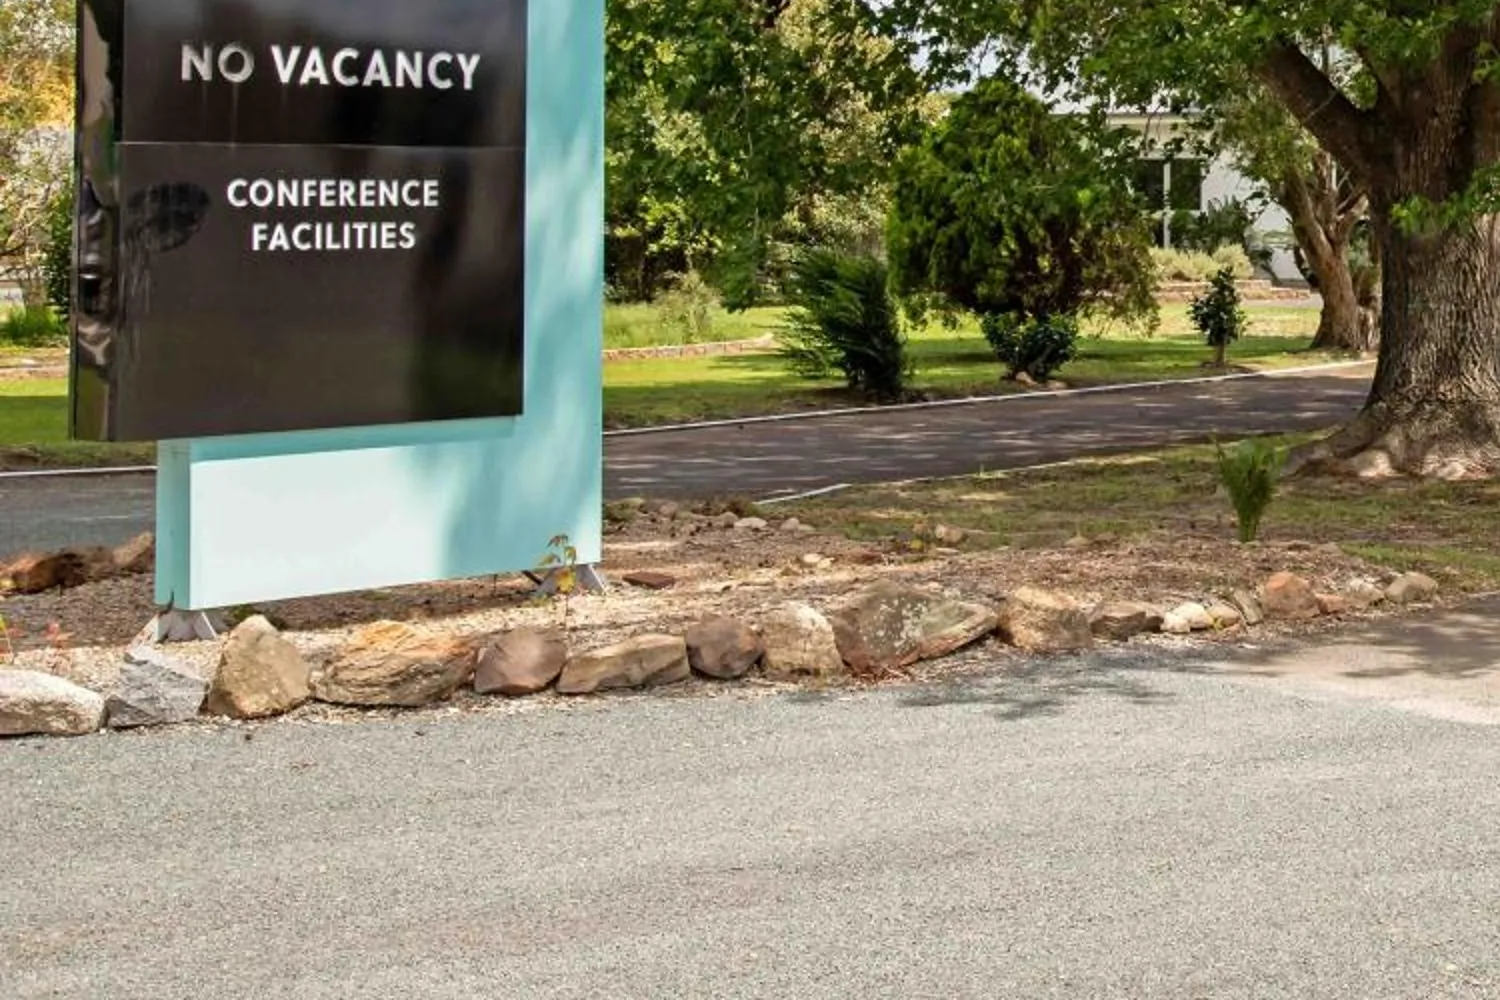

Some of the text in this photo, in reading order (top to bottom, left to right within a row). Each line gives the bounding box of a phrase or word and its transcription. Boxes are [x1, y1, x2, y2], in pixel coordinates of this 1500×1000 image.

[181, 43, 480, 90] NO VACANCY
[227, 178, 439, 208] CONFERENCE
[252, 221, 416, 250] FACILITIES
